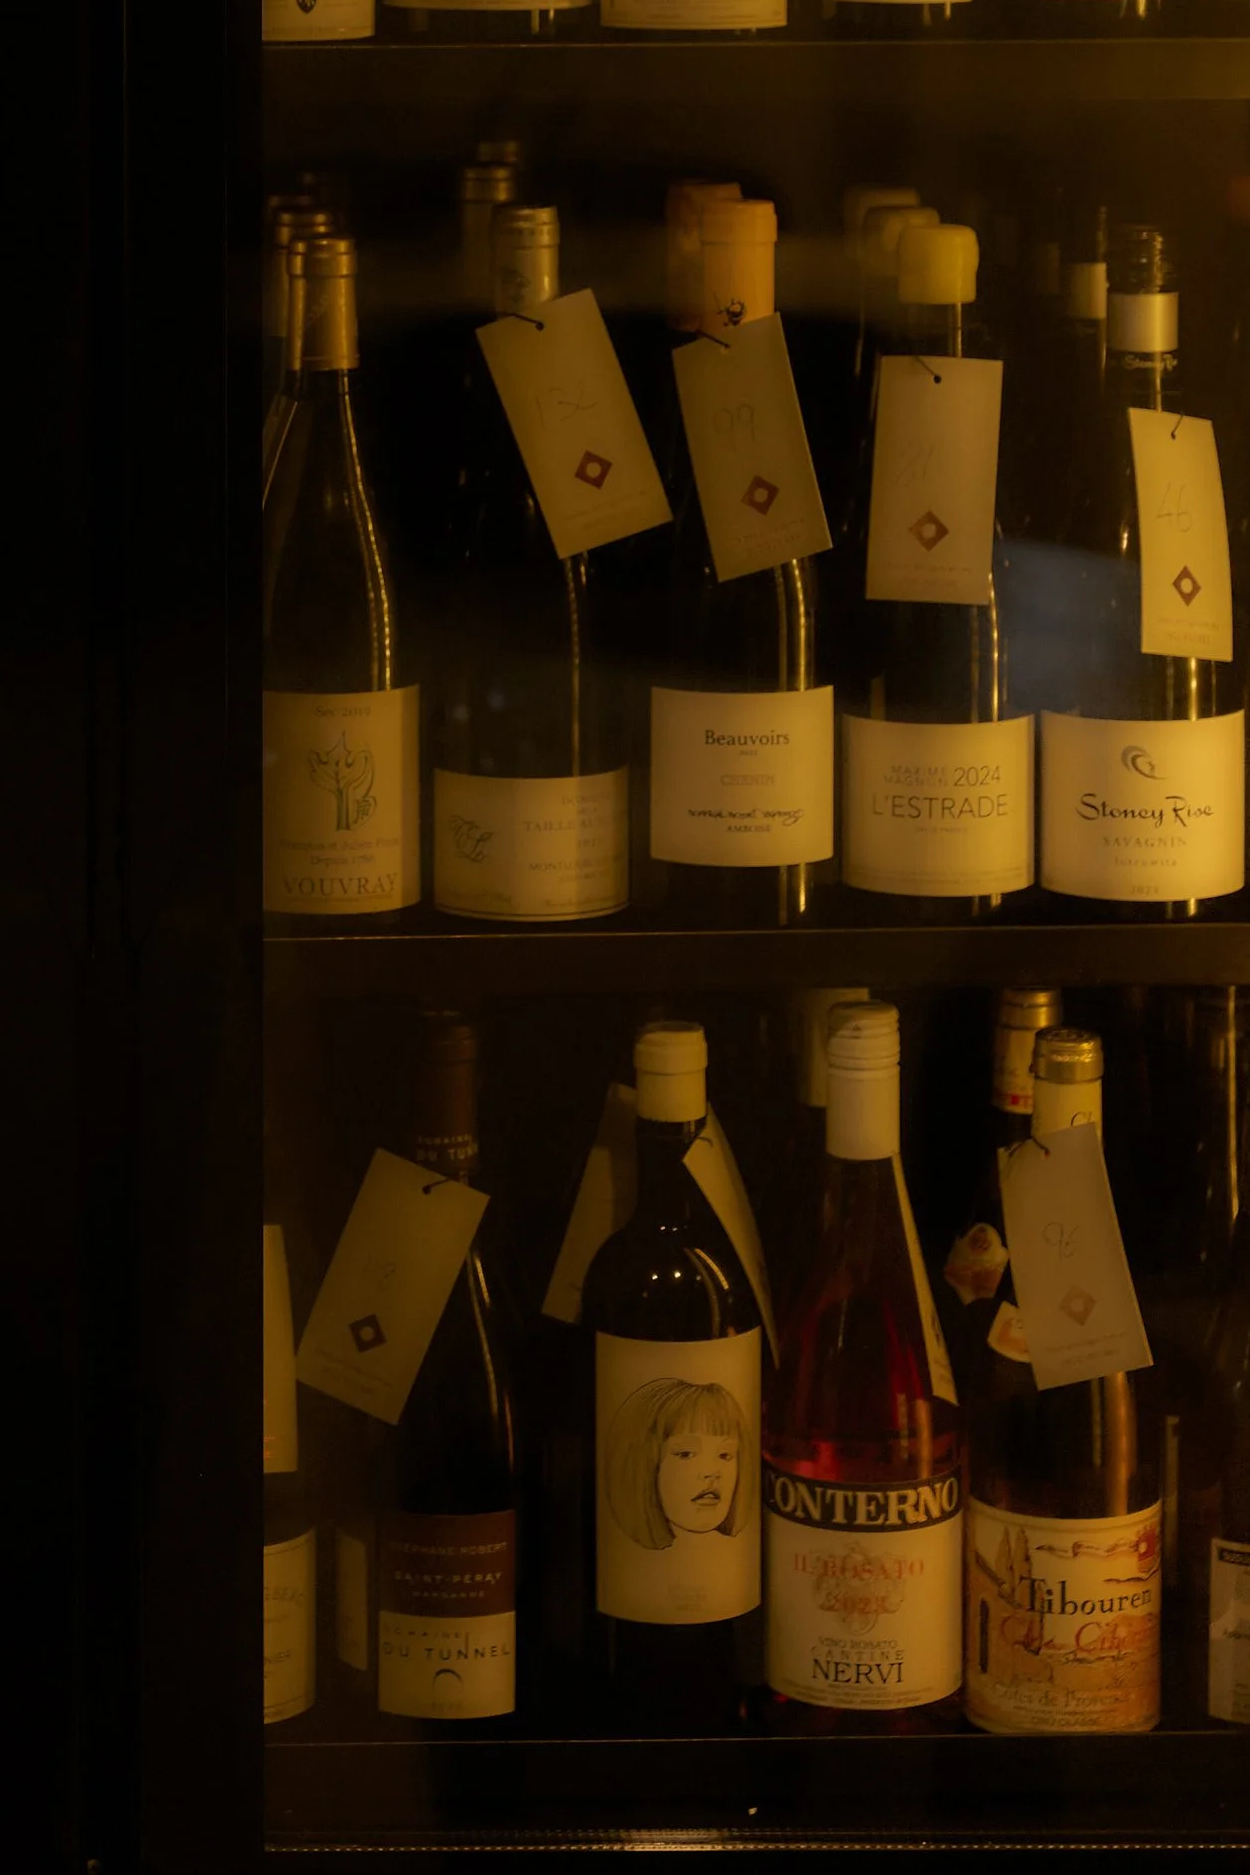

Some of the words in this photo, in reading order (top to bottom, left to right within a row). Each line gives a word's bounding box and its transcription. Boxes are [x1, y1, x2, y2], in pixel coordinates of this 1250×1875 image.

[1155, 481, 1193, 534] 46
[703, 728, 791, 748] Beauvoirs
[953, 764, 1002, 788] 2024
[872, 792, 1009, 821] L'ESTRADE
[1074, 792, 1164, 829] Stoney
[1164, 794, 1215, 829] Rise
[1101, 835, 1187, 849] SAVAGNIN
[281, 871, 399, 897] VOUVRAY
[768, 1474, 959, 1526] ONTERNO
[1019, 1574, 1152, 1617] Tibouren
[382, 1641, 410, 1658] DU
[423, 1632, 511, 1661] TUNNEL
[811, 1657, 904, 1685] NERVI
